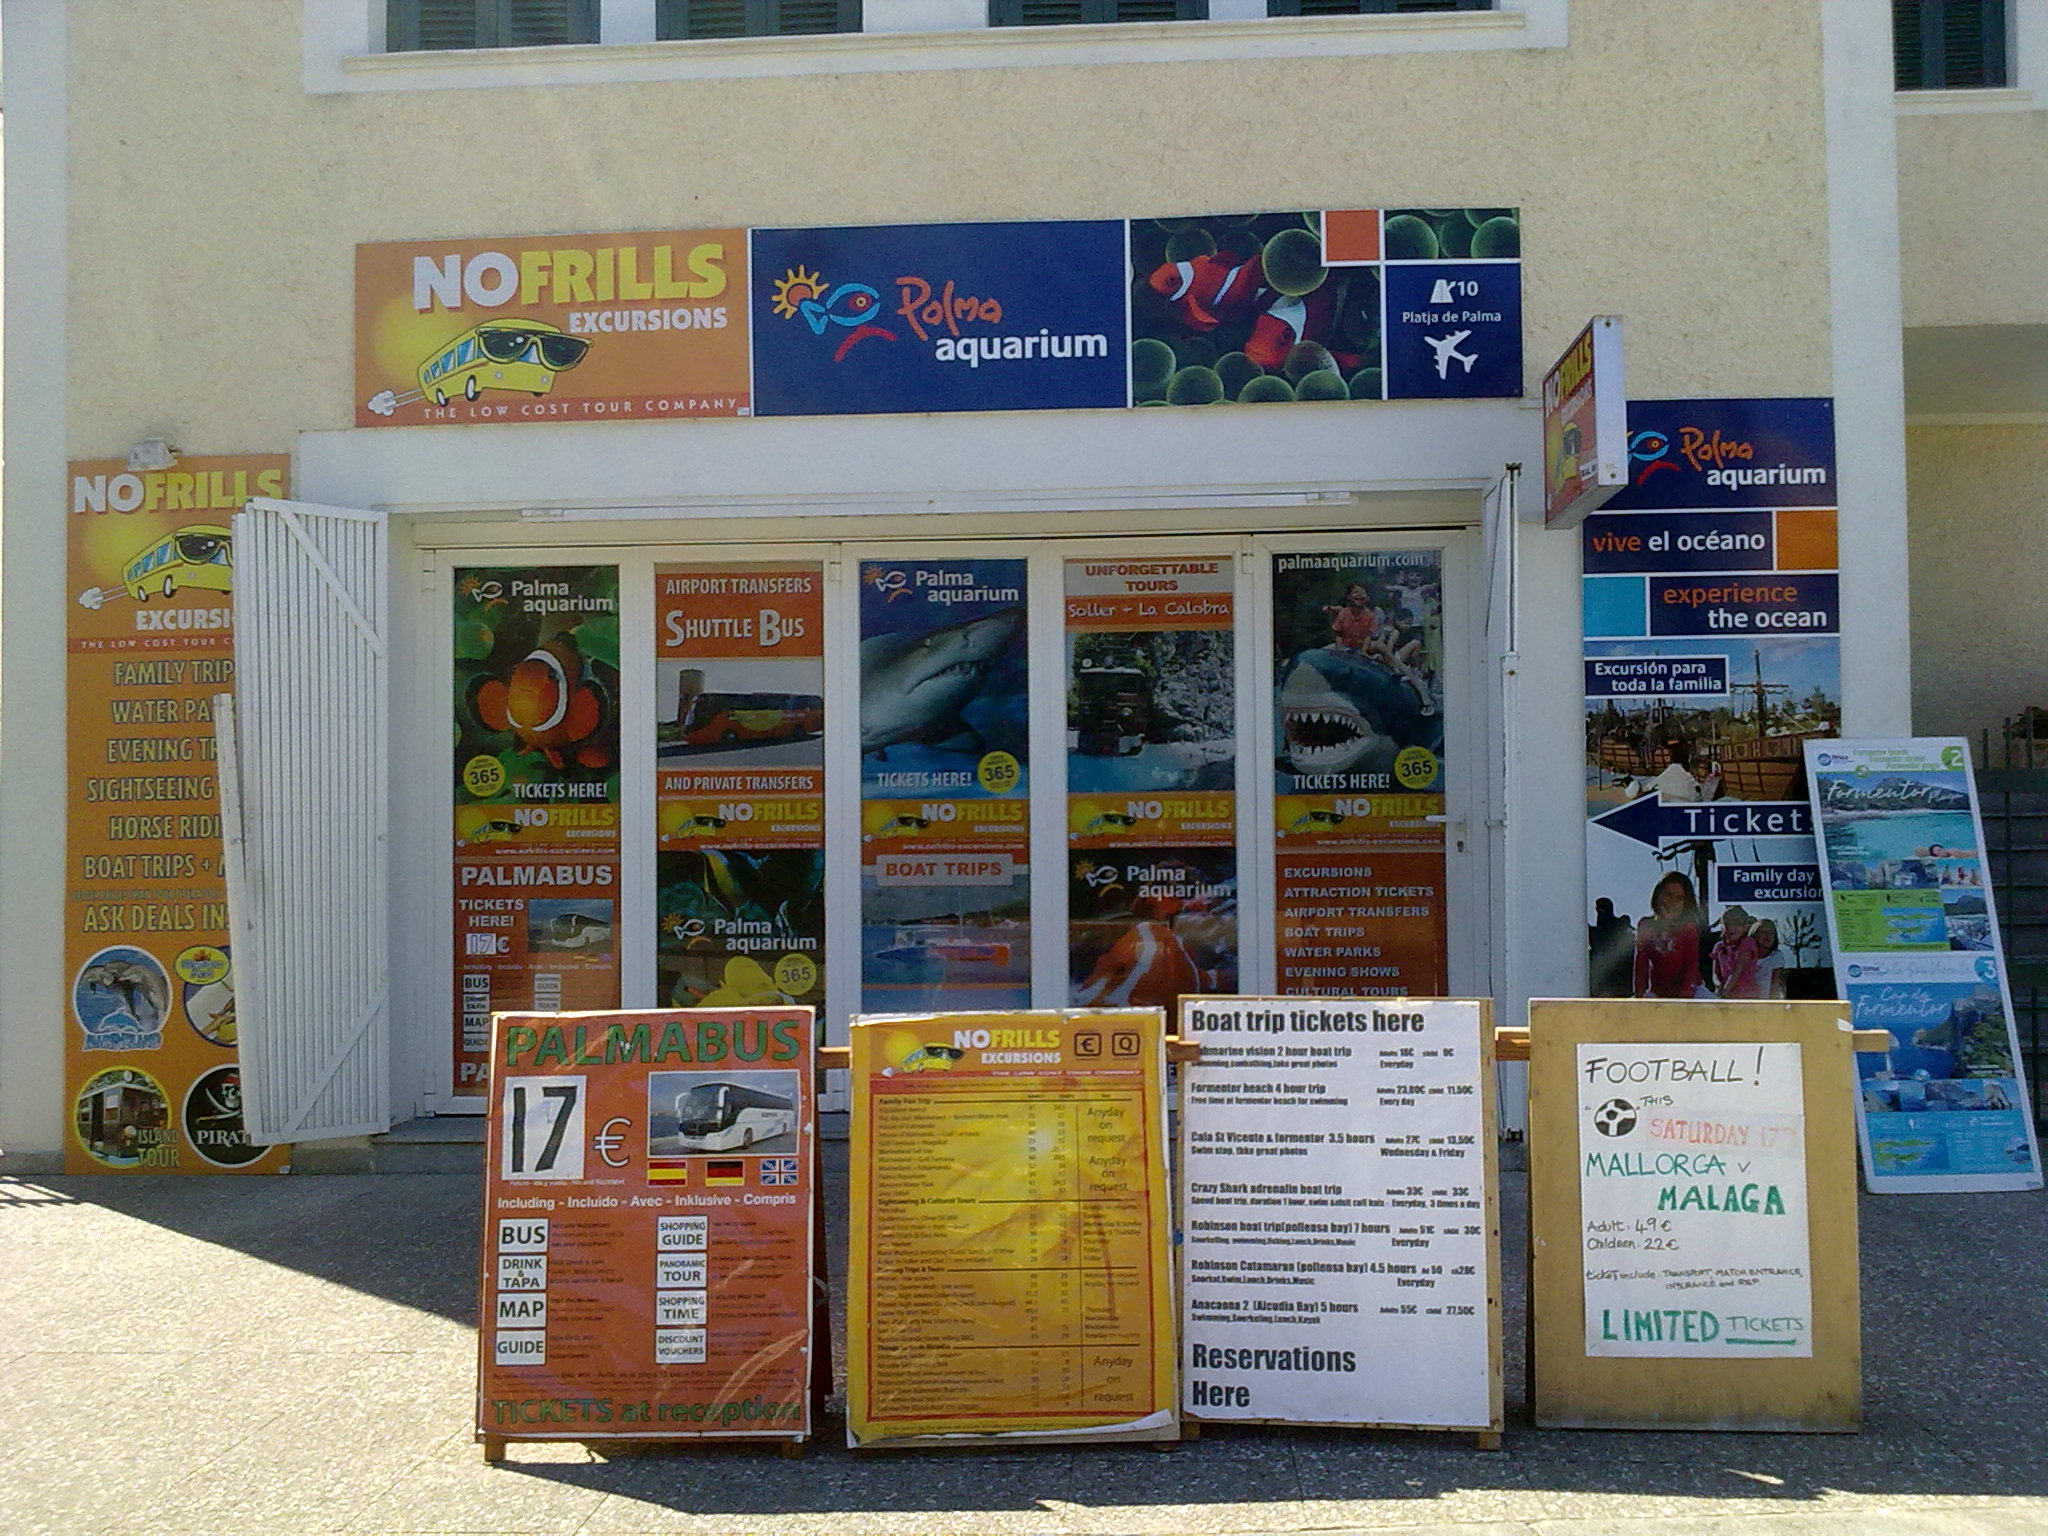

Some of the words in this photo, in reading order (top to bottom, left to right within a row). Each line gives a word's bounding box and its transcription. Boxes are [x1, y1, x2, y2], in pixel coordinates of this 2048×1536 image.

[1457, 281, 1478, 296] 10
[897, 277, 1002, 341] Palma
[569, 307, 727, 333] EXCURSIONS
[1402, 313, 1438, 325] Platja
[1442, 313, 1458, 322] de
[1463, 311, 1501, 322] Palma
[935, 329, 1107, 367] aquarium
[424, 408, 457, 419] THE
[470, 405, 508, 417] LOW
[521, 403, 569, 416] COST
[583, 401, 632, 413] TOUR
[645, 398, 737, 411] COMPANY
[1680, 427, 1753, 471] Palma
[1707, 464, 1826, 491] aquarium
[1593, 533, 1641, 552] vive
[1649, 531, 1669, 550] el
[1677, 531, 1765, 550] océano
[1086, 564, 1218, 576] UNFORGETTABLE
[1278, 555, 1423, 572] palmaaquarium.com
[666, 579, 728, 594] AIRPORT
[731, 578, 811, 593] TRANSFERS
[916, 571, 974, 587] Palma
[1126, 580, 1178, 591] TOURS
[511, 580, 568, 596] Palma
[928, 585, 1019, 605] aquarium
[1663, 583, 1798, 608] experience
[524, 595, 613, 615] aquarium
[1069, 603, 1115, 618] Soller
[1139, 602, 1157, 616] La
[137, 608, 235, 630] EXCURSI
[1708, 609, 1748, 628] the
[1755, 609, 1827, 628] ocean
[114, 660, 185, 685] FAMILY
[191, 659, 235, 683] TRIP
[1595, 663, 1668, 675] Excursión
[1672, 664, 1706, 678] para
[1612, 679, 1647, 691] toda
[1651, 679, 1665, 691] la
[1669, 677, 1722, 691] familia
[112, 699, 178, 723] WATER
[108, 739, 192, 762] EVENING
[1952, 750, 1963, 766] 2
[470, 768, 500, 784] 365
[984, 765, 1015, 782] 365
[1402, 760, 1432, 777] 365
[665, 777, 691, 790] AND
[694, 777, 742, 790] PRIVATE
[746, 776, 813, 789] TRANSFERS
[878, 773, 929, 787] TICKETS
[933, 772, 972, 786] HERE!
[1294, 774, 1346, 789] TICKETS
[1350, 773, 1390, 788] HERE!
[87, 776, 214, 801] SIGHTSEEING
[513, 783, 565, 798] TICKETS
[569, 783, 607, 798] HERE!
[110, 816, 172, 840] HORSE
[180, 816, 222, 839] RIDI
[1684, 808, 1813, 833] Ticket
[84, 856, 136, 879] BOAT
[141, 855, 195, 877] TRIPS
[886, 863, 937, 876] BOAT
[945, 863, 1002, 876] TRIPS
[1126, 866, 1185, 882] Palma
[1285, 867, 1372, 878] EXCURSIONS
[461, 866, 613, 886] PALMABUS
[1733, 869, 1784, 884] Family
[1787, 869, 1814, 884] day
[1139, 881, 1231, 901] aquarium
[1285, 887, 1370, 898] ATTRACTION
[1375, 886, 1433, 897] TICKETS
[460, 900, 524, 910] TICKETS
[1285, 907, 1343, 918] AIRPORT
[1349, 906, 1429, 917] TRANSFERS
[83, 905, 125, 932] ASK
[131, 904, 195, 932] DEALS
[203, 904, 229, 930] IN
[469, 916, 514, 927] HERE!
[714, 918, 771, 935] Palma
[1285, 927, 1320, 938] BOAT
[1325, 926, 1364, 938] TRIPS
[726, 936, 817, 953] aquarium
[1286, 947, 1331, 957] WATER
[1336, 946, 1381, 957] PARKS
[781, 968, 811, 983] 365
[1286, 966, 1346, 978] EVENING
[1351, 966, 1400, 977] SHOWS
[1984, 960, 1995, 979] 3
[464, 977, 488, 988] BUS
[1192, 1010, 1241, 1032] Boat
[1246, 1010, 1284, 1033] trip
[1290, 1010, 1367, 1032] tickets
[1372, 1010, 1424, 1032] here
[507, 1020, 800, 1067] PALMABUS
[981, 1052, 1061, 1065] EXCURSIONS
[1191, 1083, 1241, 1092] Formentor
[1243, 1083, 1273, 1093] beach
[1275, 1084, 1281, 1092] 4
[1284, 1084, 1306, 1093] hour
[1308, 1084, 1326, 1094] trip
[1640, 1095, 1673, 1106] THIS
[1088, 1107, 1124, 1119] Anyday
[138, 1128, 178, 1143] ISLAND
[512, 1085, 578, 1173] 17
[593, 1117, 632, 1167] €
[1650, 1118, 1749, 1145] SATURDAY
[1088, 1133, 1126, 1145] request
[137, 1148, 179, 1167] TOUR
[1089, 1156, 1126, 1168] Anyday
[1586, 1153, 1726, 1177] MALLORCA
[1090, 1182, 1128, 1193] request
[1192, 1183, 1217, 1194] Crazy
[1220, 1183, 1248, 1193] Shark
[1300, 1184, 1322, 1194] boat
[1325, 1185, 1342, 1195] trip
[498, 1197, 554, 1210] Including
[568, 1196, 618, 1209] Incluido
[630, 1195, 662, 1208] Avec
[675, 1194, 732, 1207] Inklusive
[743, 1193, 796, 1206] Compris
[1658, 1184, 1785, 1215] MALAGA
[660, 1221, 705, 1231] SHOPPING
[501, 1227, 545, 1245] BUS
[662, 1234, 703, 1246] GUIDE
[502, 1259, 542, 1270] DRINK
[660, 1259, 705, 1268] PANORAMIC
[503, 1278, 540, 1288] TAPA
[664, 1271, 701, 1282] TOUR
[658, 1296, 704, 1306] SHOPPING
[500, 1301, 544, 1318] MAP
[663, 1309, 699, 1319] TIME
[1603, 1309, 1719, 1342] LIMITED
[1726, 1317, 1803, 1332] TICKETS
[497, 1341, 544, 1354] GUIDE
[658, 1335, 704, 1344] DISCOUNT
[658, 1346, 704, 1355] VOUCHERS
[1193, 1344, 1356, 1372] Reservations
[1094, 1356, 1133, 1367] Anyday
[1094, 1393, 1133, 1402] request
[1193, 1381, 1250, 1407] Here
[492, 1398, 613, 1424] TICKETS
[620, 1402, 649, 1422] at
[658, 1397, 800, 1426] reception
